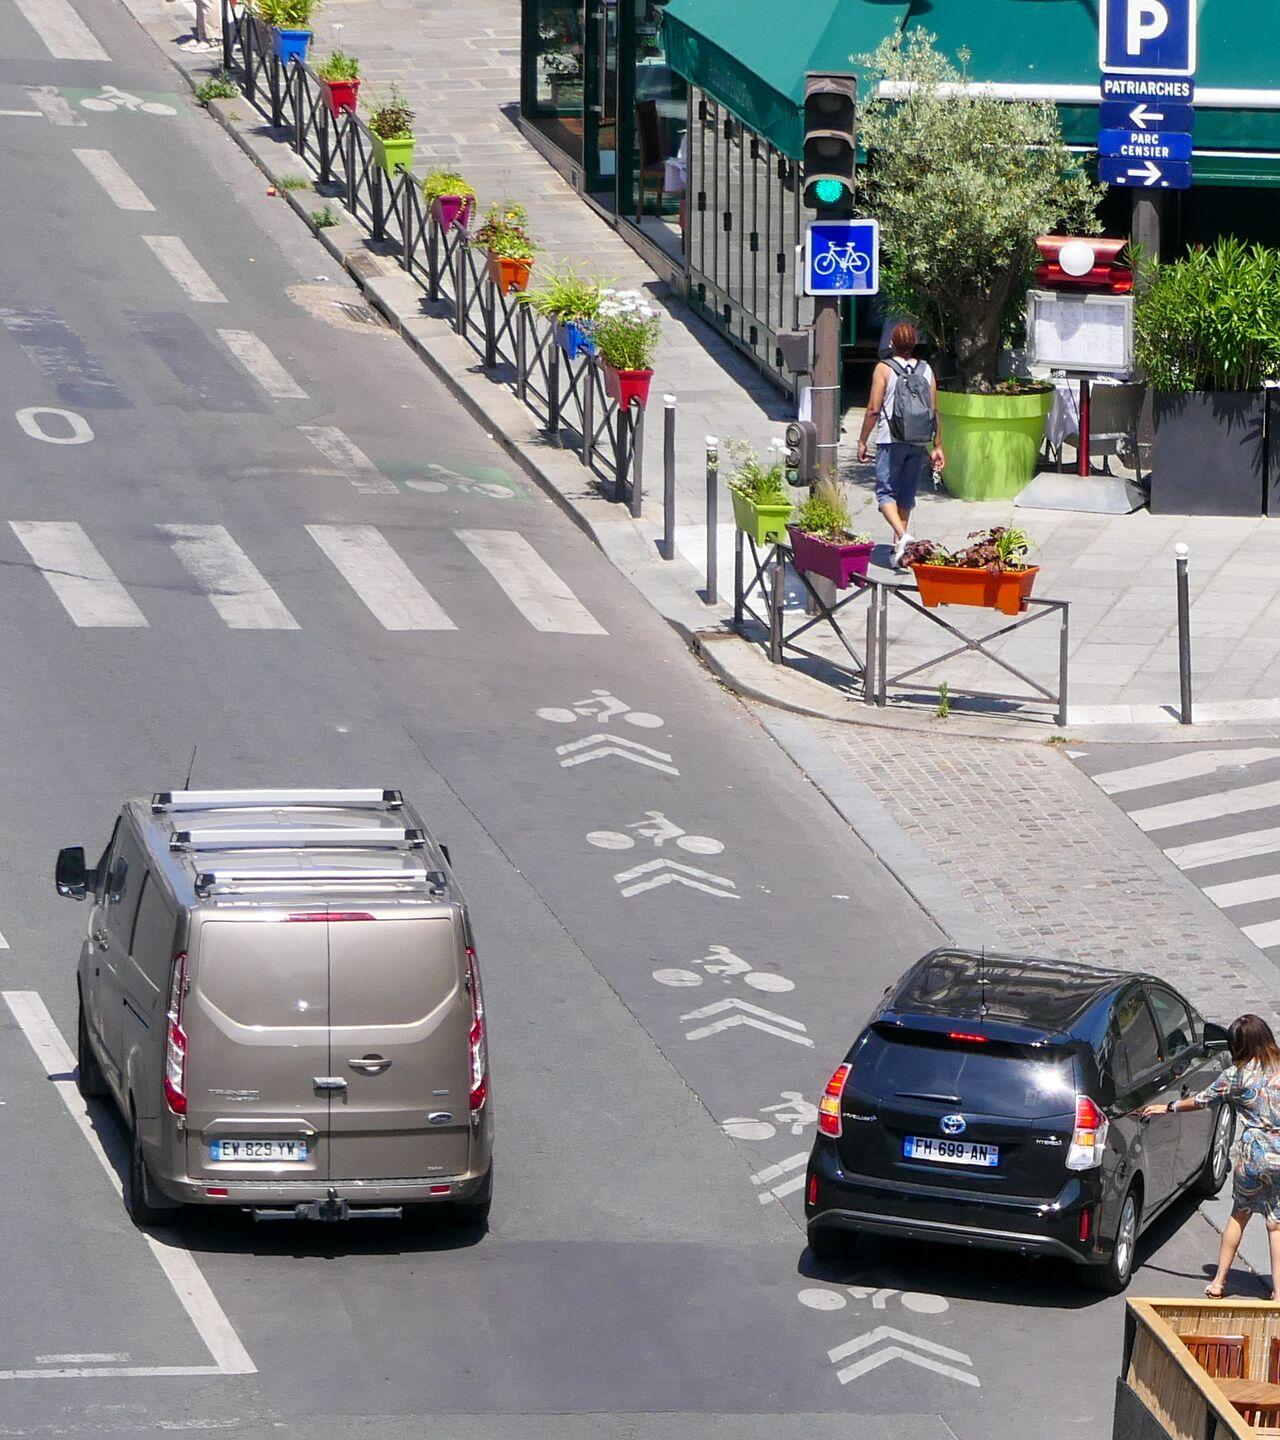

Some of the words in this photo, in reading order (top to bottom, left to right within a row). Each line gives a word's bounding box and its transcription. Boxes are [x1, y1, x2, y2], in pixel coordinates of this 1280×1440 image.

[1127, 0, 1168, 55] P
[1104, 80, 1190, 97] PATRIARCHES
[1131, 133, 1159, 145] PARC
[1120, 145, 1169, 158] CENSIER
[915, 1138, 988, 1161] FM-699-AN
